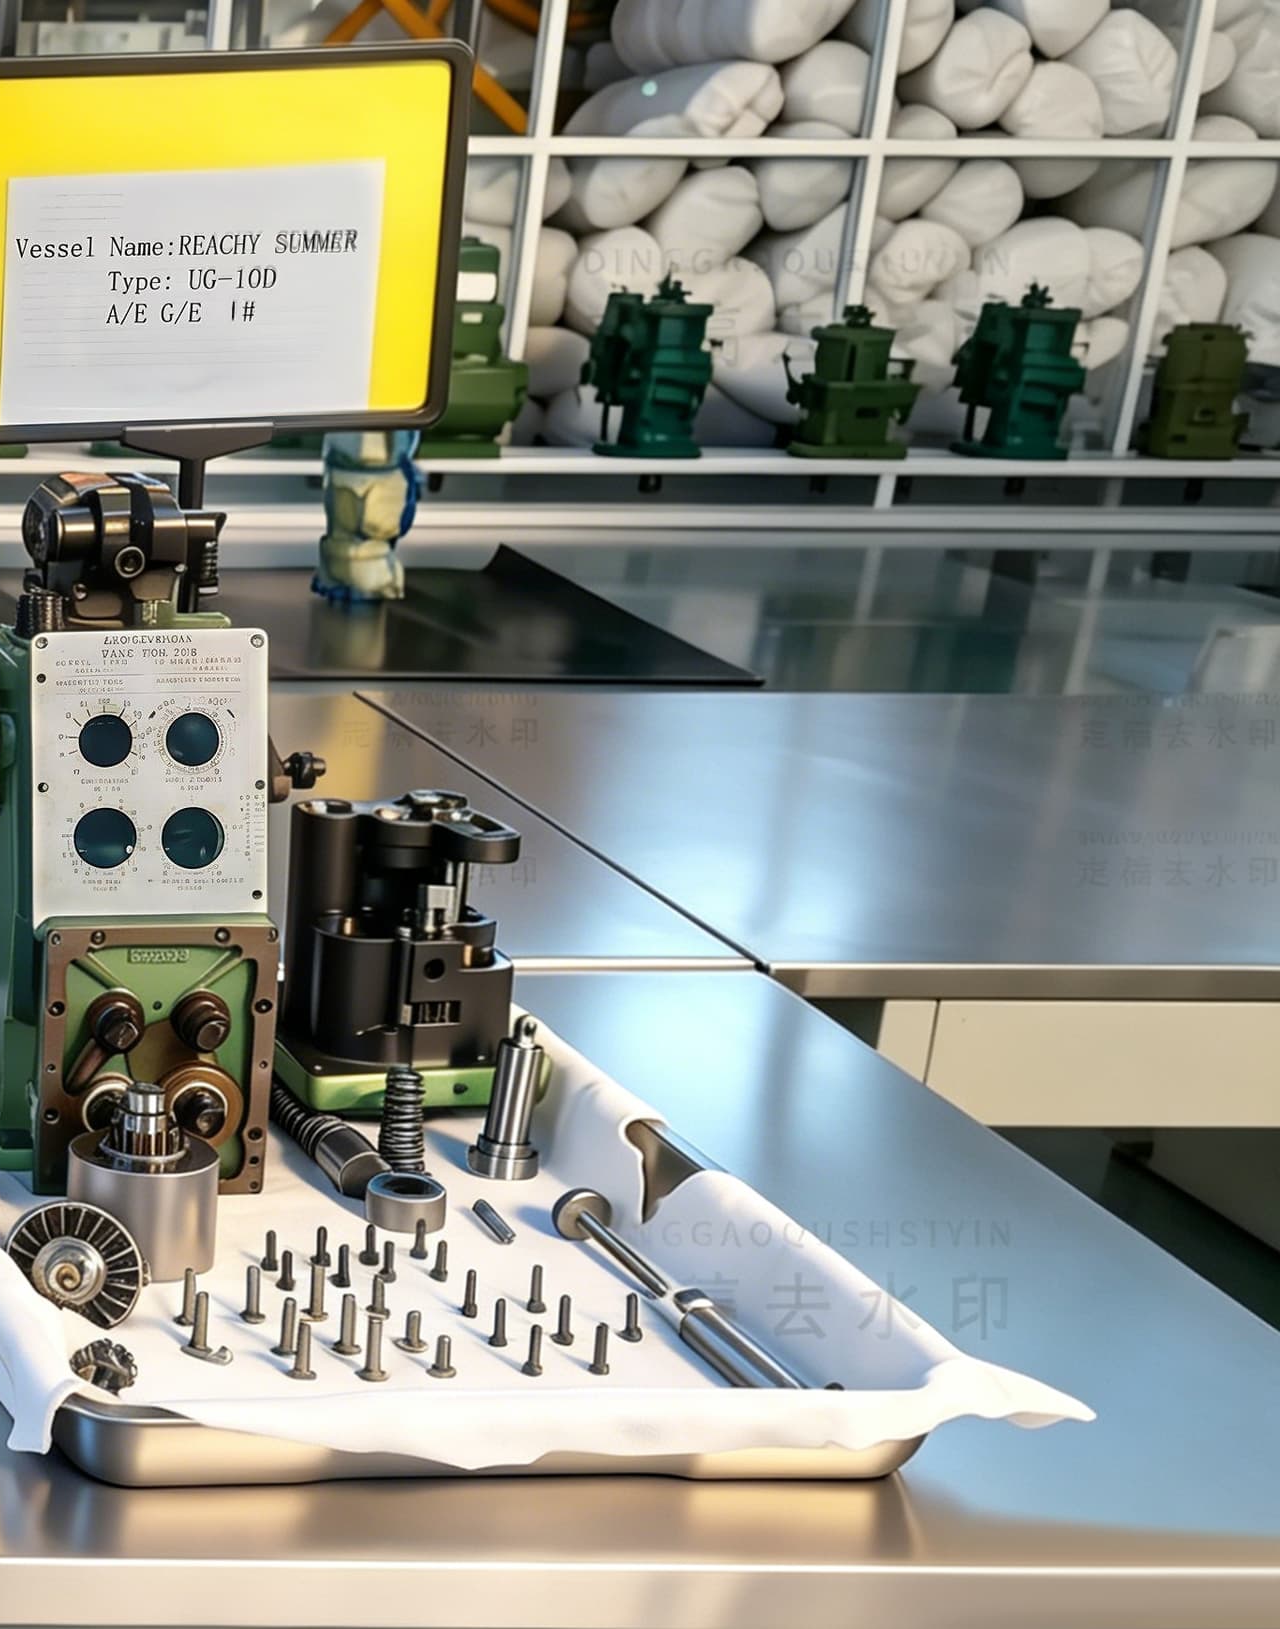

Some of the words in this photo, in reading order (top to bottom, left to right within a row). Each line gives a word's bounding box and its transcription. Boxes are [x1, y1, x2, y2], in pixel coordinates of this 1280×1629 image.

[15, 236, 95, 259] Vessel
[109, 231, 263, 258] Name:REACHY
[274, 228, 359, 255] SUMMER
[105, 270, 171, 296] Type:
[188, 266, 278, 291] UG-10D
[105, 301, 148, 326] A/E
[160, 300, 202, 325] G/E
